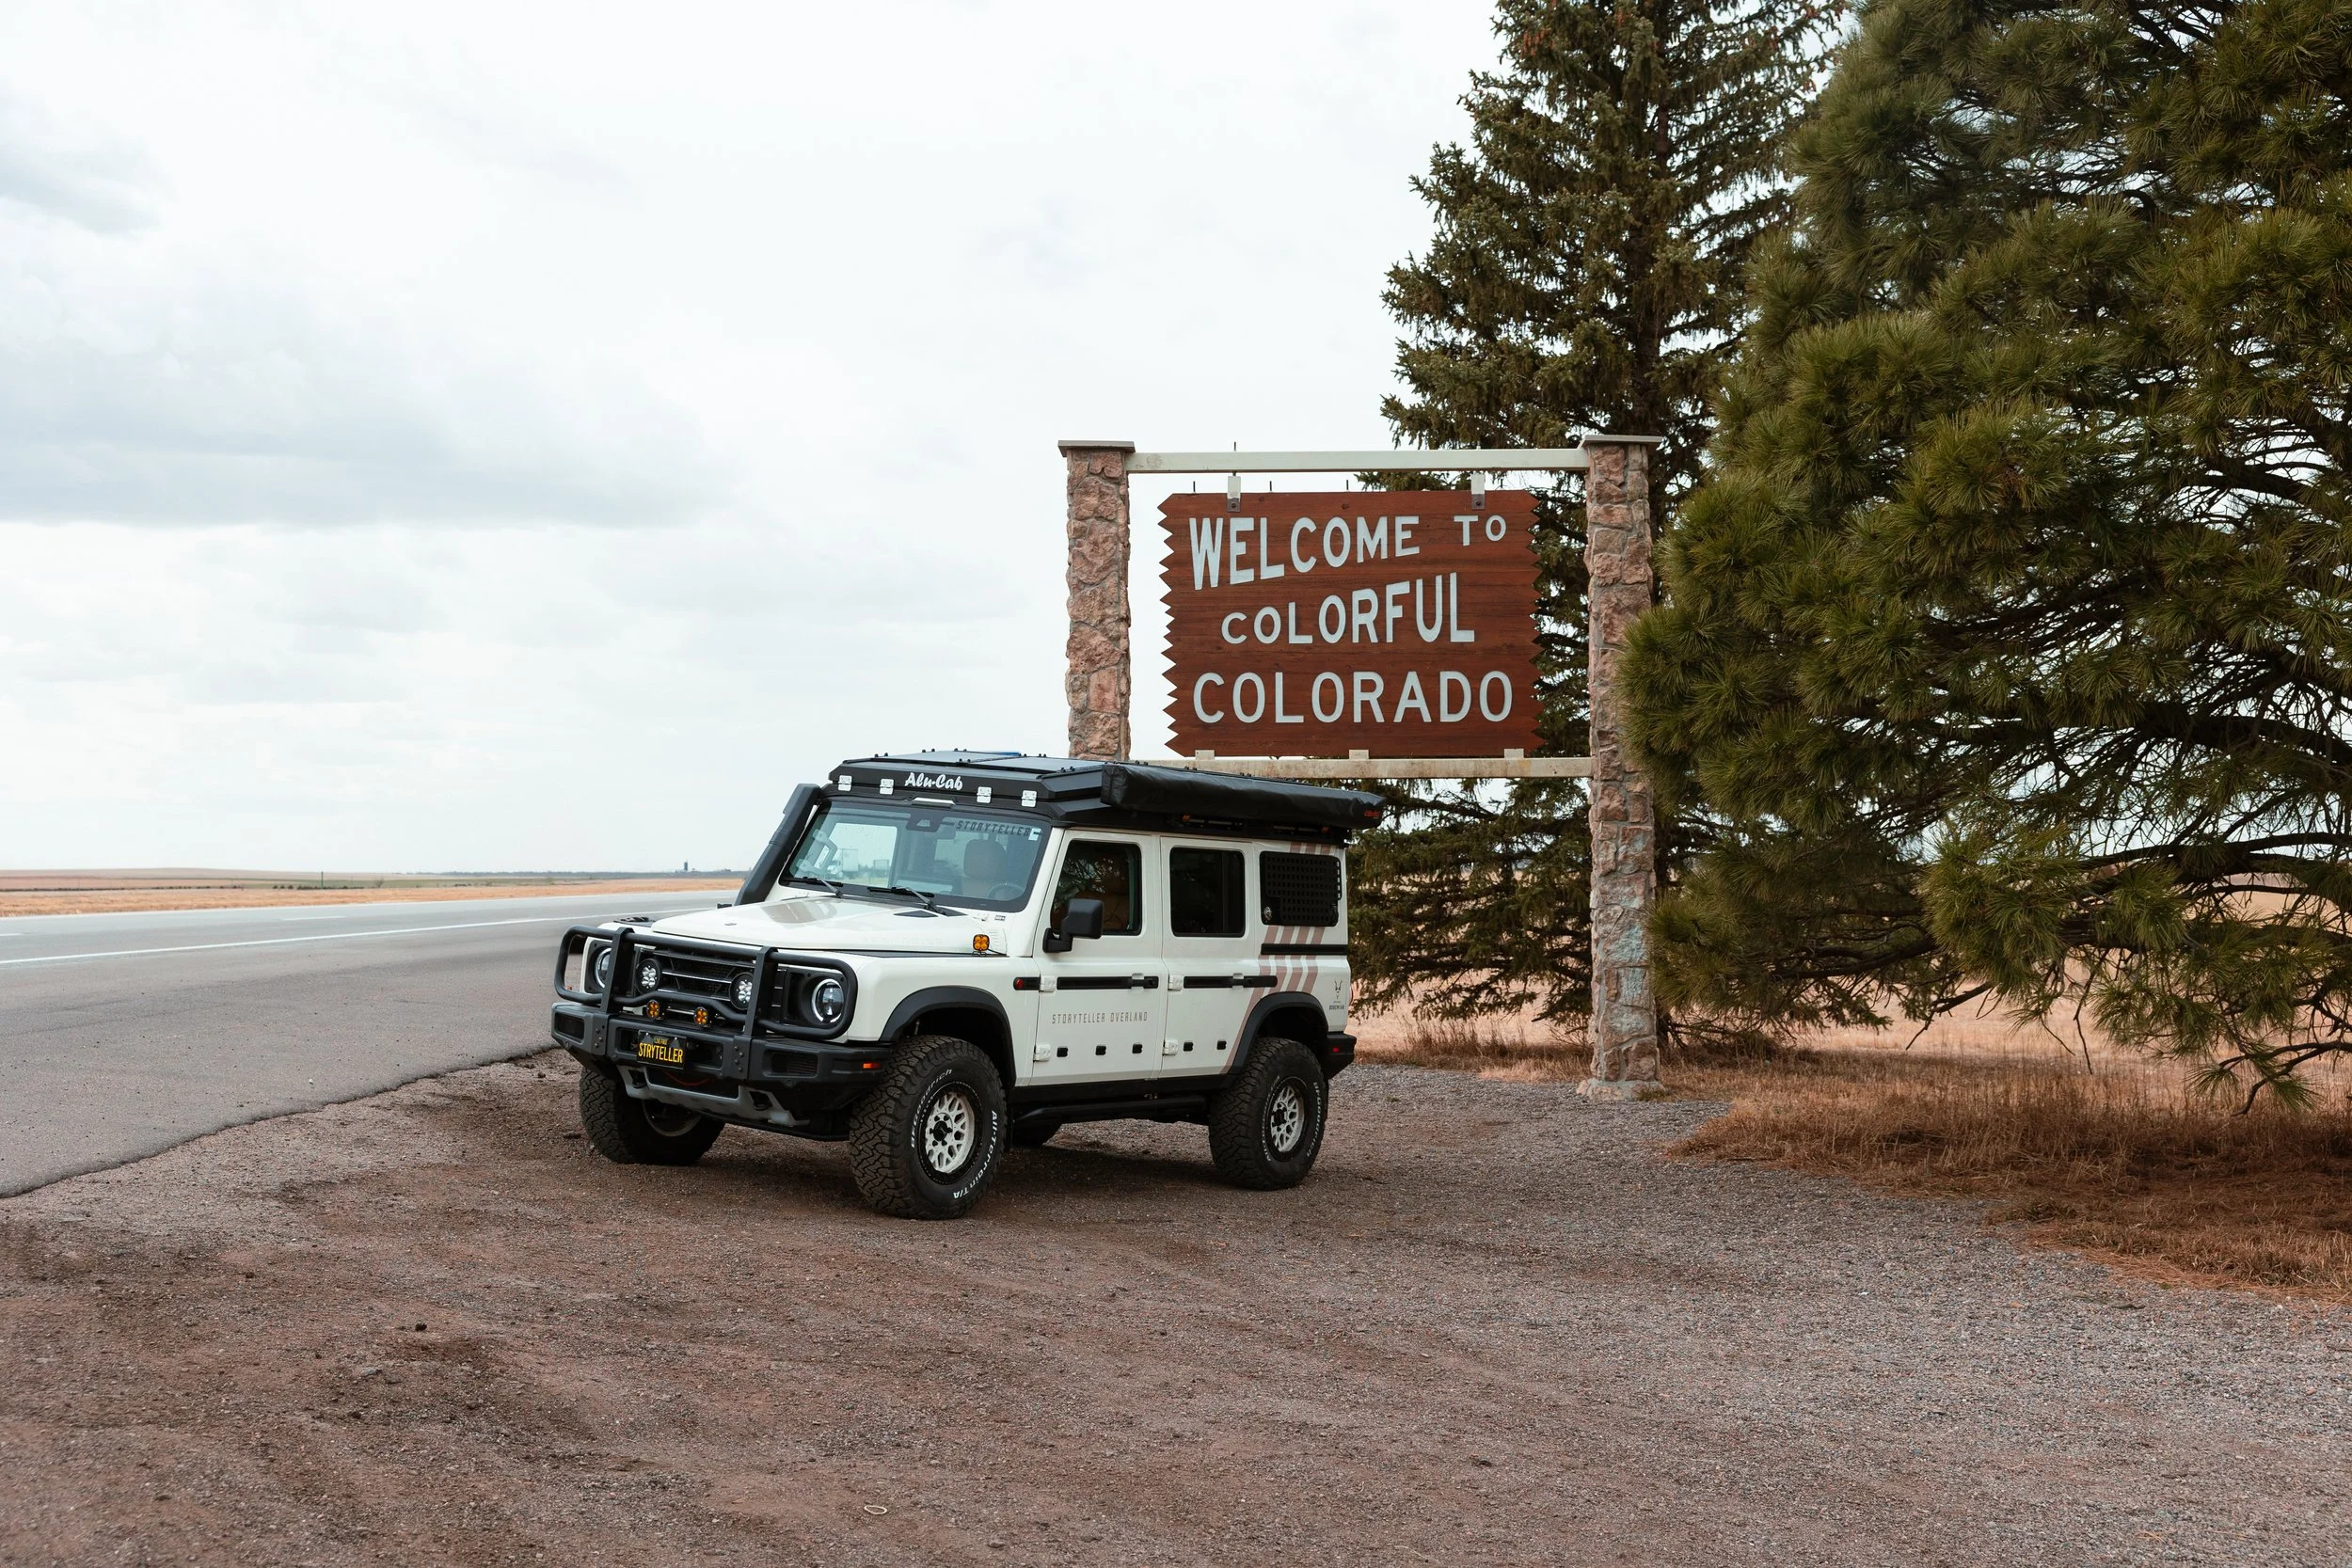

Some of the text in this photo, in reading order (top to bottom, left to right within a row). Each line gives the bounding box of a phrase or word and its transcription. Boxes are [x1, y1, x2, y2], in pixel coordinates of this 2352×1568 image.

[1189, 515, 1507, 591] WELCOME TO
[1221, 572, 1475, 644] COLORFUL
[1192, 671, 1513, 723] COLORADO
[904, 771, 963, 791] Alu-Cab
[956, 819, 1032, 837] STORYTELLER
[1051, 1011, 1148, 1024] STORYTELLER OVERLAND
[638, 1041, 684, 1064] STRYTELLER
